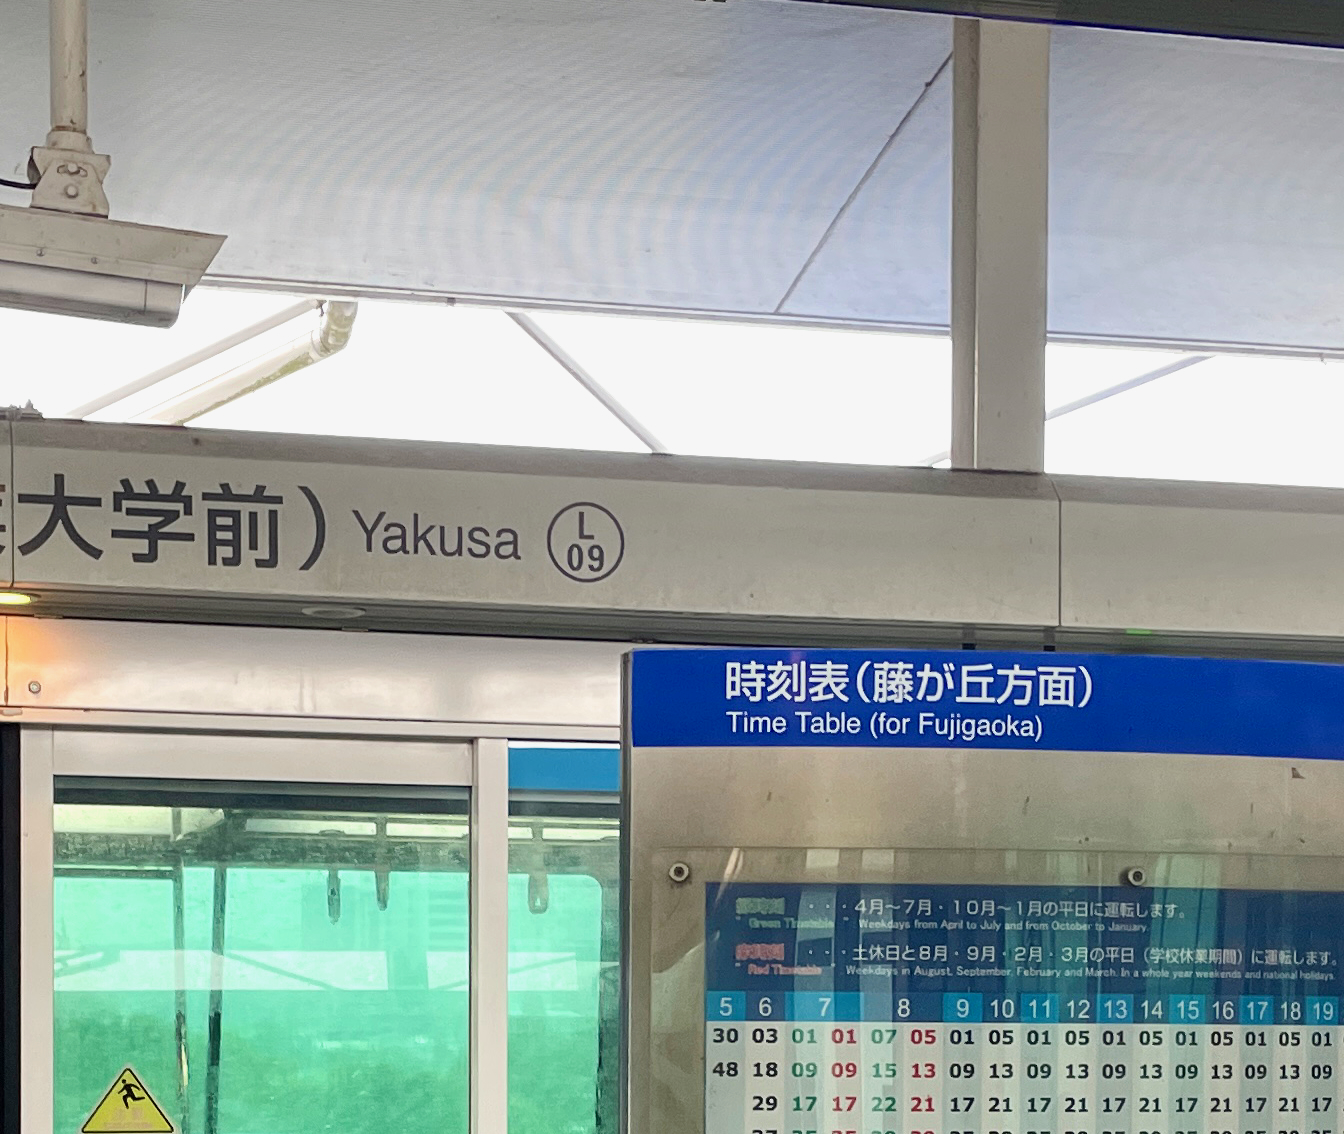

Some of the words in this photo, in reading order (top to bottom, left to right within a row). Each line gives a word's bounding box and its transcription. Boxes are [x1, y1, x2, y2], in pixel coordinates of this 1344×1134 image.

[352, 508, 523, 564] Yakusa
[578, 511, 595, 540] L
[567, 543, 604, 572] 09
[725, 660, 1093, 708] 時刻表(藤が丘方面)
[725, 711, 787, 734] Time
[795, 711, 861, 735] Table
[870, 711, 910, 739] (for
[919, 712, 1043, 743] Fujigaoka)
[914, 919, 938, 929] from
[940, 920, 964, 931] April
[966, 921, 977, 930] to
[980, 920, 1002, 932] July
[1005, 920, 1023, 931] and
[1025, 920, 1049, 931] from
[1051, 920, 1091, 931] October
[719, 998, 733, 1017] 5
[759, 998, 772, 1017] 6
[818, 998, 832, 1017] 7
[897, 999, 911, 1018] 8
[956, 999, 970, 1018] 9
[991, 999, 1015, 1018] 10
[1029, 999, 1051, 1018] 11
[1067, 999, 1090, 1019] 12
[1104, 1000, 1128, 1019] 13
[1141, 1000, 1163, 1020] 14
[1177, 1001, 1199, 1020] 15
[1212, 1001, 1234, 1020] 16
[1247, 1001, 1269, 1020] 17
[1281, 1002, 1301, 1021] 18
[1314, 1002, 1333, 1021] 19
[713, 1028, 738, 1043] 30
[752, 1028, 778, 1043] 03
[792, 1029, 817, 1043] 01
[832, 1029, 856, 1044] 01
[871, 1029, 897, 1044] 07
[911, 1030, 936, 1044] 05
[950, 1030, 974, 1044] 01
[989, 1030, 1013, 1045] 05
[1027, 1030, 1051, 1045] 01
[1066, 1031, 1089, 1045] 05
[1103, 1031, 1126, 1045] 01
[1140, 1031, 1162, 1045] 05
[1176, 1031, 1198, 1046] 01
[1211, 1031, 1233, 1046] 05
[1245, 1032, 1267, 1046] 01
[1279, 1032, 1300, 1046] 05
[1312, 1032, 1332, 1047] 01
[713, 1062, 738, 1077] 48
[753, 1062, 778, 1077] 18
[792, 1063, 817, 1078] 09
[832, 1063, 857, 1078] 09
[872, 1063, 896, 1078] 15
[912, 1063, 935, 1078] 13
[950, 1064, 974, 1078] 09
[989, 1064, 1013, 1078] 13
[1027, 1064, 1051, 1079] 09
[1066, 1064, 1089, 1079] 13
[1102, 1064, 1126, 1079] 09
[1140, 1064, 1162, 1079] 13
[1175, 1064, 1198, 1079] 09
[1212, 1065, 1232, 1079] 13
[1245, 1065, 1267, 1079] 09
[1280, 1065, 1299, 1079] 13
[1312, 1065, 1332, 1079] 09
[753, 1096, 777, 1111] 29
[793, 1096, 817, 1111] 17
[833, 1097, 856, 1111] 17
[872, 1096, 897, 1112] 22
[911, 1095, 934, 1112] 21
[951, 1097, 975, 1112] 17
[989, 1097, 1013, 1112] 21
[1028, 1098, 1051, 1112] 17
[1065, 1098, 1088, 1112] 21
[1103, 1098, 1126, 1112] 17
[1139, 1098, 1161, 1112] 21
[1176, 1098, 1198, 1112] 17
[1211, 1098, 1232, 1112] 21
[1246, 1098, 1267, 1112] 17
[1279, 1097, 1299, 1112] 21
[1312, 1097, 1332, 1112] 17
